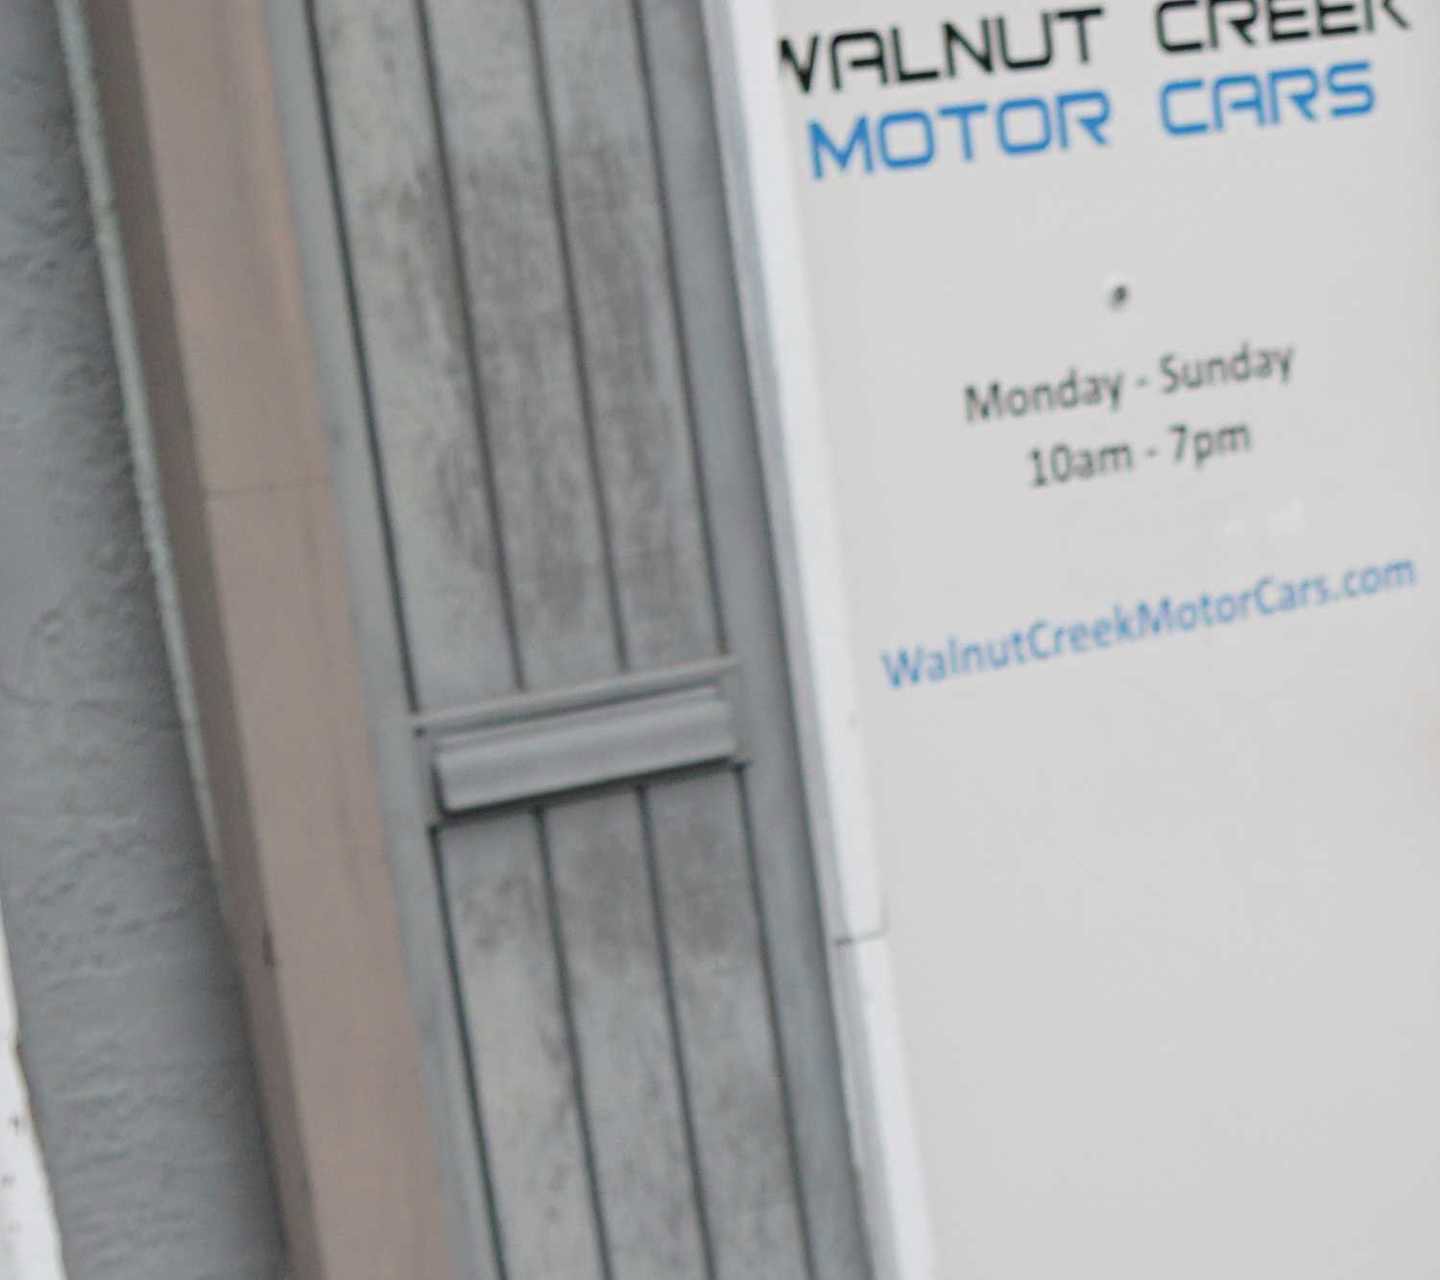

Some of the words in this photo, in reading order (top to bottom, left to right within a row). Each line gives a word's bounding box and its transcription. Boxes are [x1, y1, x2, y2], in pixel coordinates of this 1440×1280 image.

[806, 90, 1111, 180] MOTOR
[1160, 60, 1375, 136] CARS
[963, 368, 1124, 424] Monday
[1158, 341, 1296, 397] Sunday
[1027, 440, 1135, 489] 10am
[1168, 420, 1252, 470] 7pm
[880, 556, 1418, 691] WalnutCreekMotorCars.com
